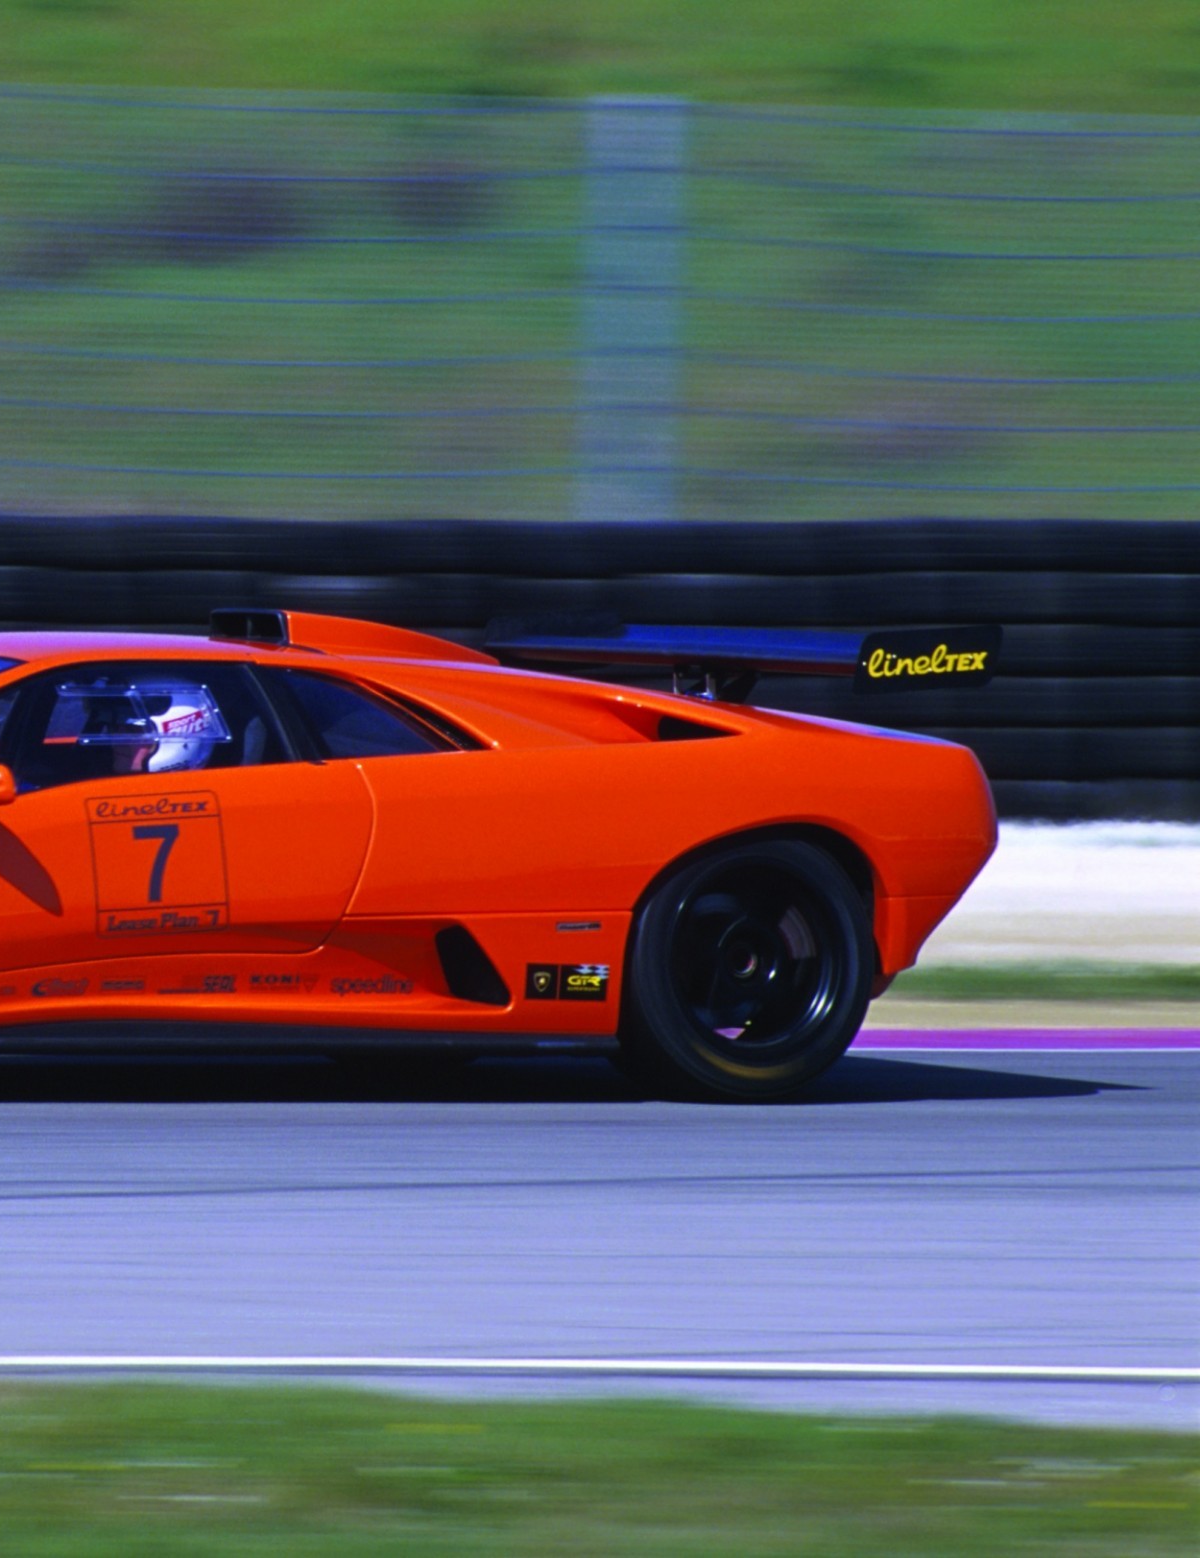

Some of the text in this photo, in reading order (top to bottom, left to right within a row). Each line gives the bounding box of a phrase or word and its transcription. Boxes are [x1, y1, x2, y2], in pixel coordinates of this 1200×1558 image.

[132, 823, 180, 903] 7
[107, 914, 157, 933] Lease
[160, 911, 199, 929] Plan
[330, 973, 414, 996] speedline
